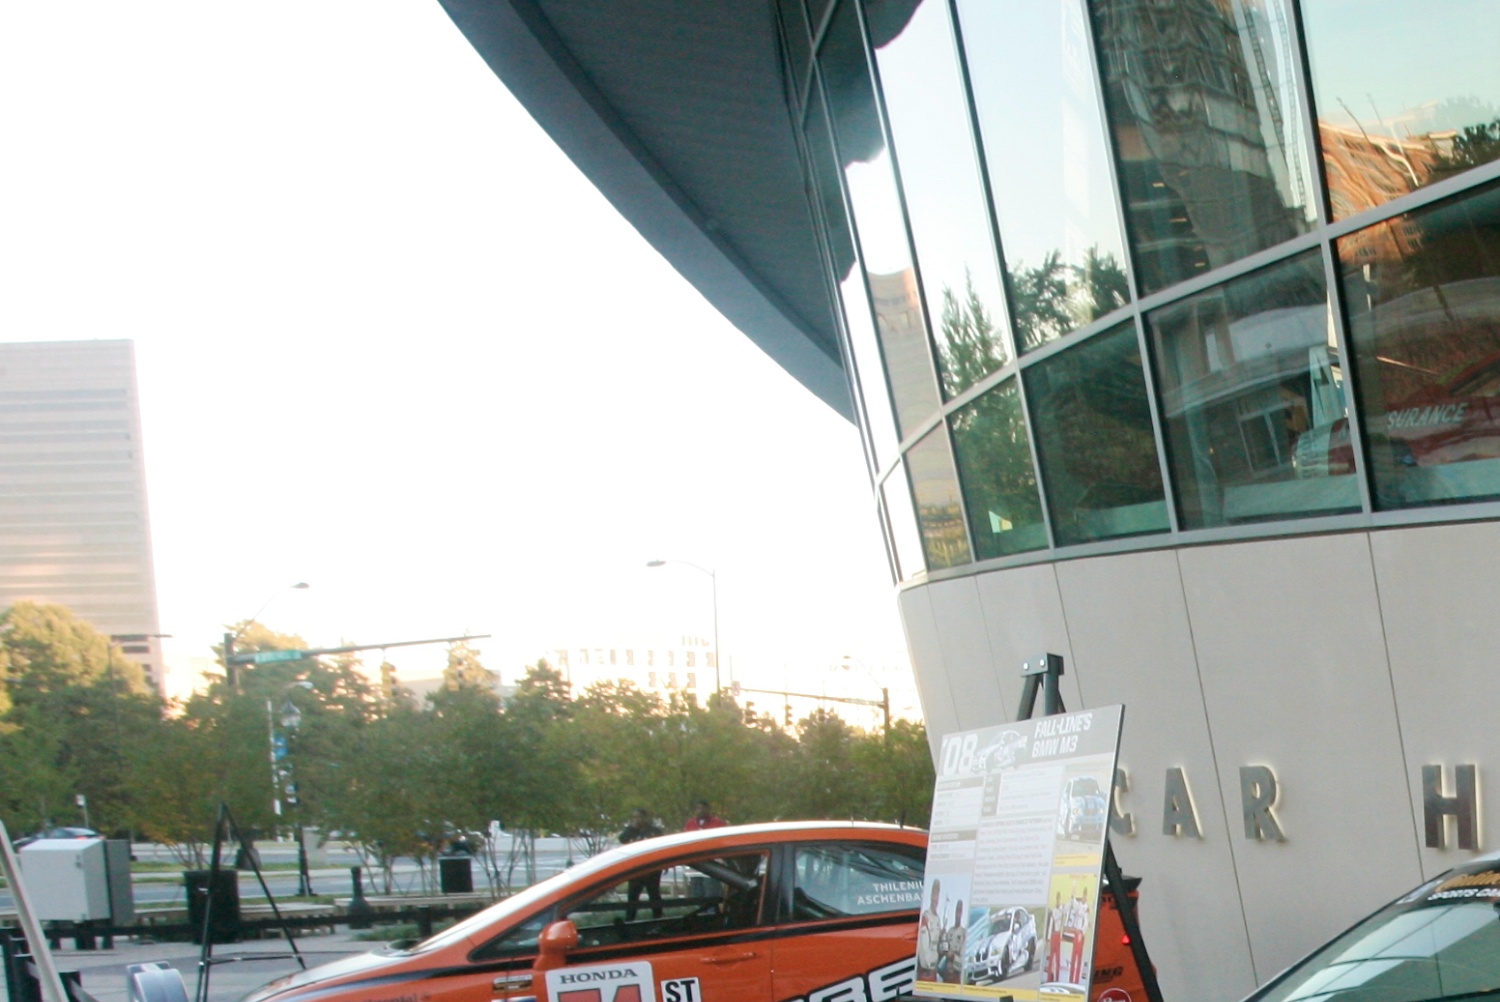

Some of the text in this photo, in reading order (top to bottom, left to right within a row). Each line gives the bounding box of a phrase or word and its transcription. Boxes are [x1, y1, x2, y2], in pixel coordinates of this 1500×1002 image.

[1032, 735, 1079, 759] BMW M3
[560, 968, 638, 984] HONDA
